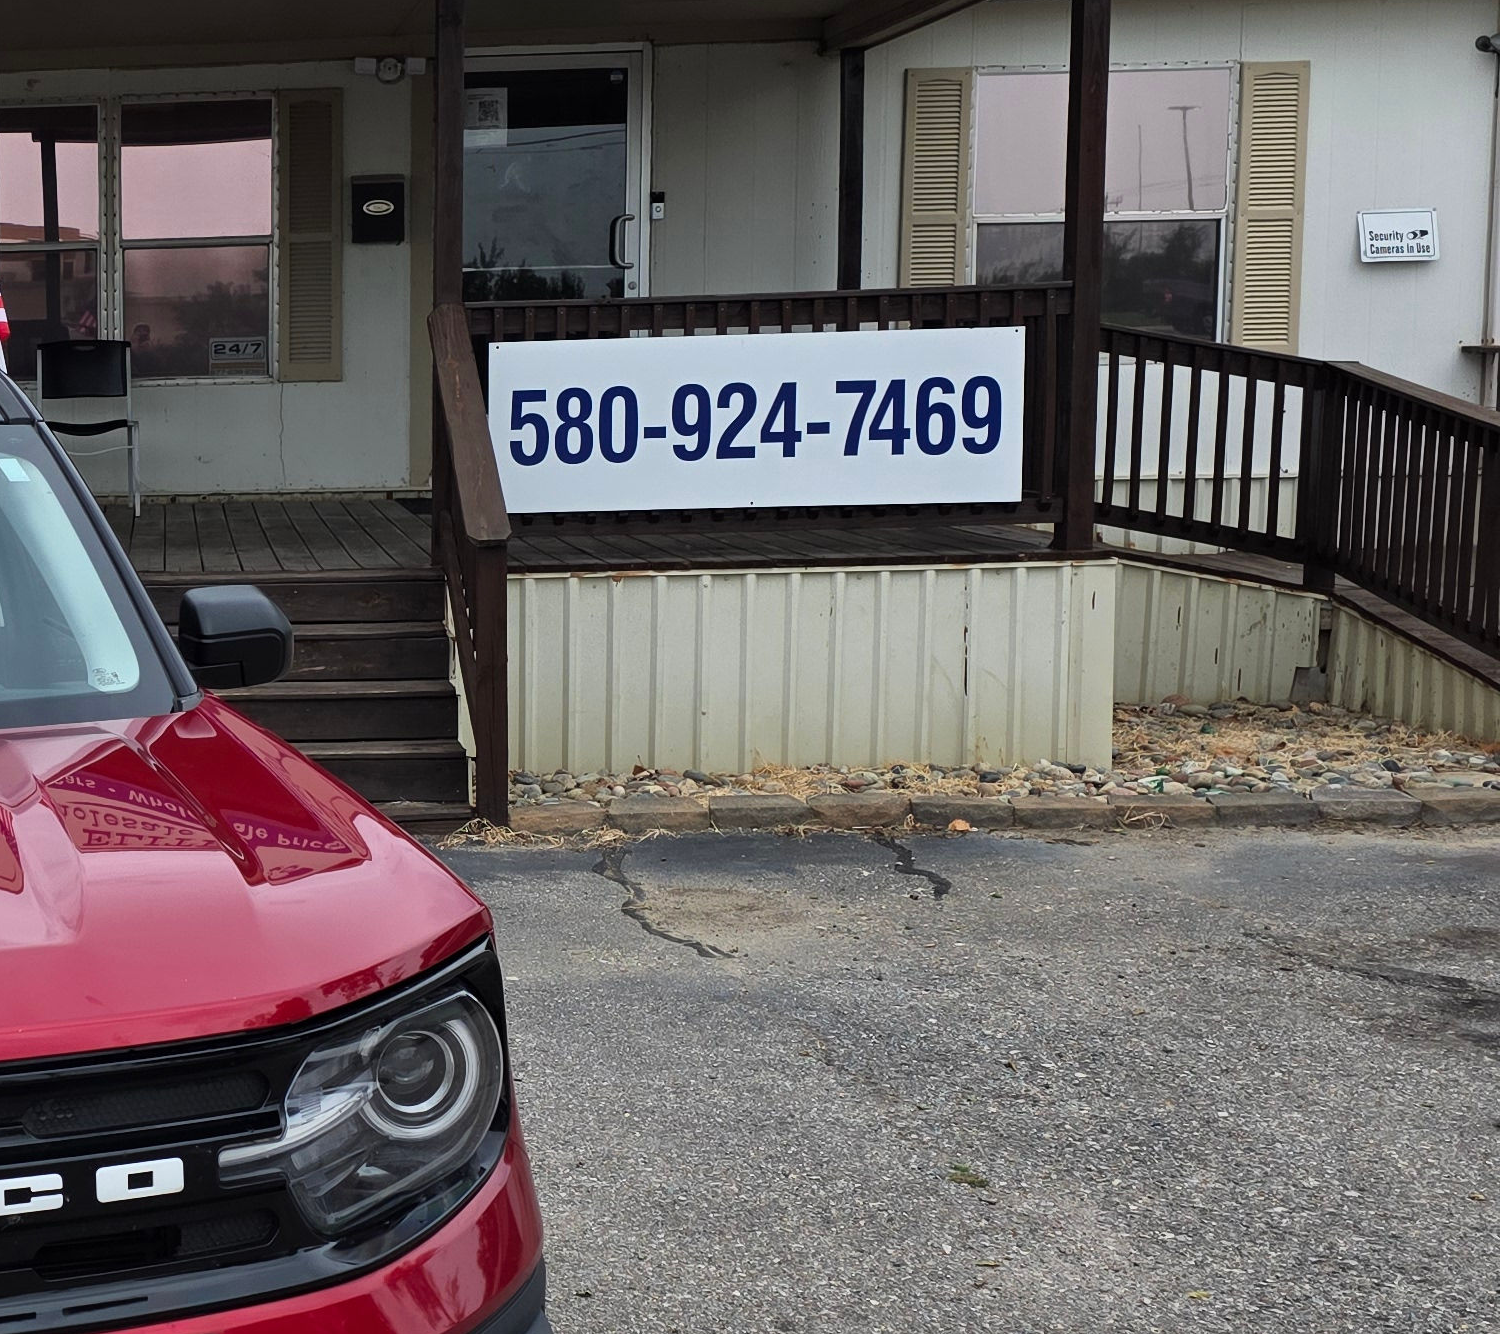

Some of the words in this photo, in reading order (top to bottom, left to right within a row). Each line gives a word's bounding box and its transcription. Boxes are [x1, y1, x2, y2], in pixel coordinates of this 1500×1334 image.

[1368, 230, 1404, 243] Security
[1369, 243, 1405, 255] Cameras
[1416, 242, 1431, 254] Use
[213, 342, 262, 355] 24/7
[509, 375, 1002, 466] 580-924-7469
